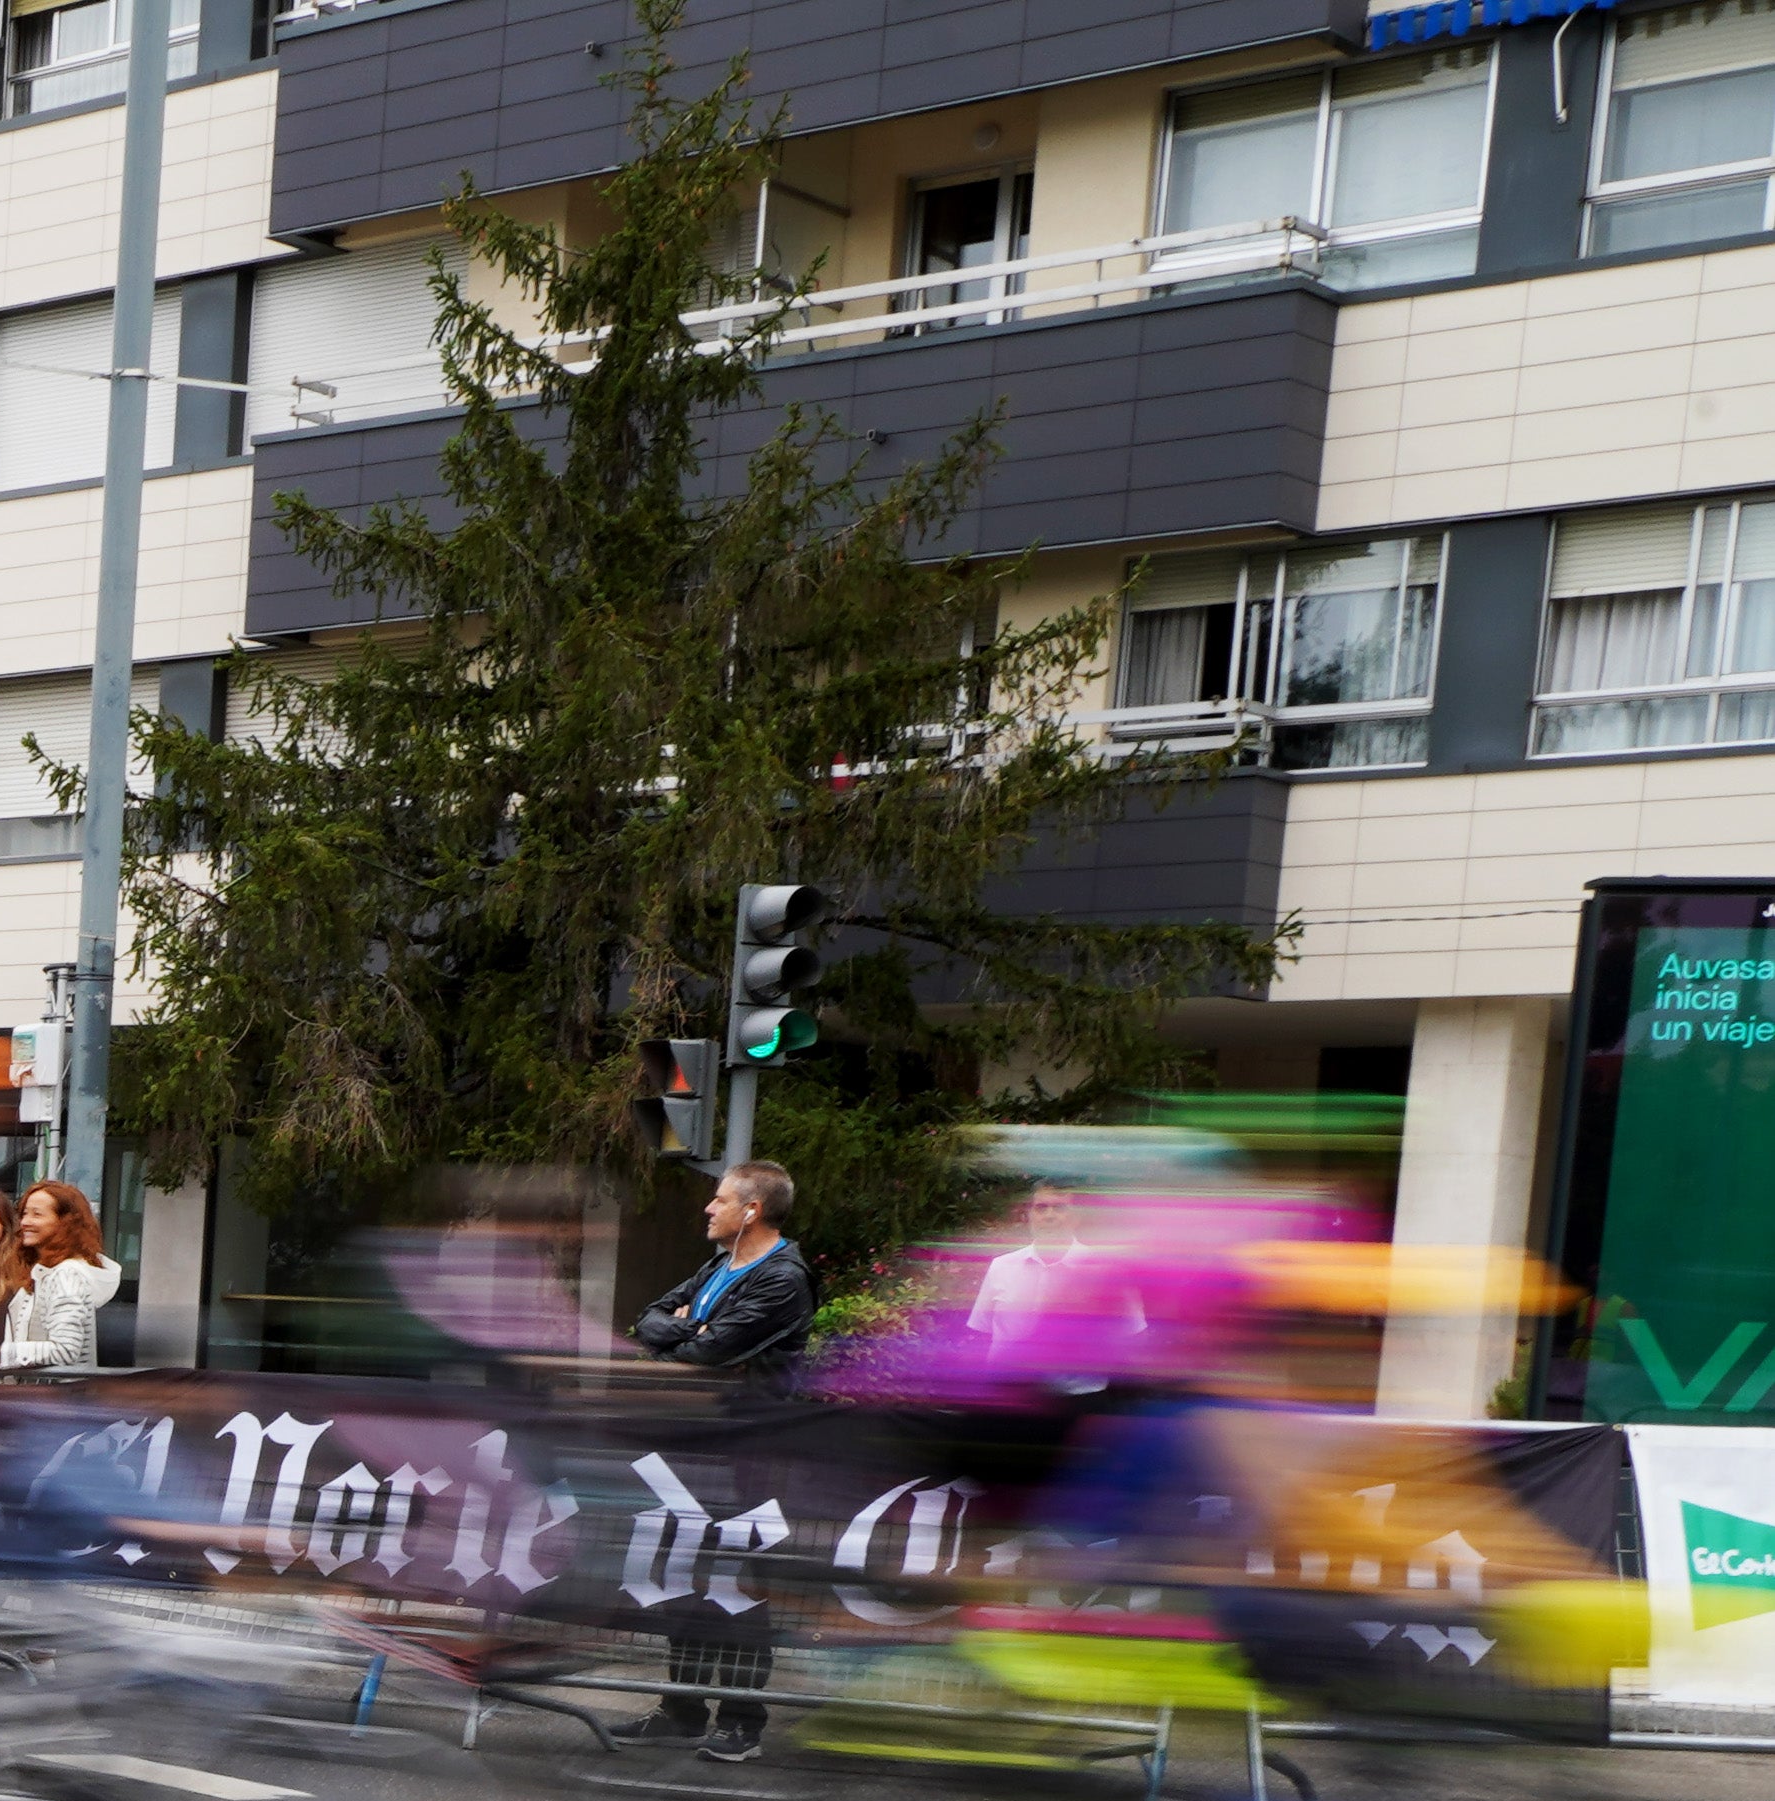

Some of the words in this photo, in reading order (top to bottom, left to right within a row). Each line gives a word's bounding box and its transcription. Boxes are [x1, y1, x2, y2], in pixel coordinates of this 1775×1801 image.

[1657, 952, 1775, 980] Auvasa
[1654, 983, 1738, 1010] inicia
[1652, 1021, 1693, 1041] un
[1702, 1014, 1775, 1049] viaje
[203, 1411, 580, 1596] Norte
[618, 1451, 792, 1616] de
[1721, 1549, 1775, 1576] Cort
